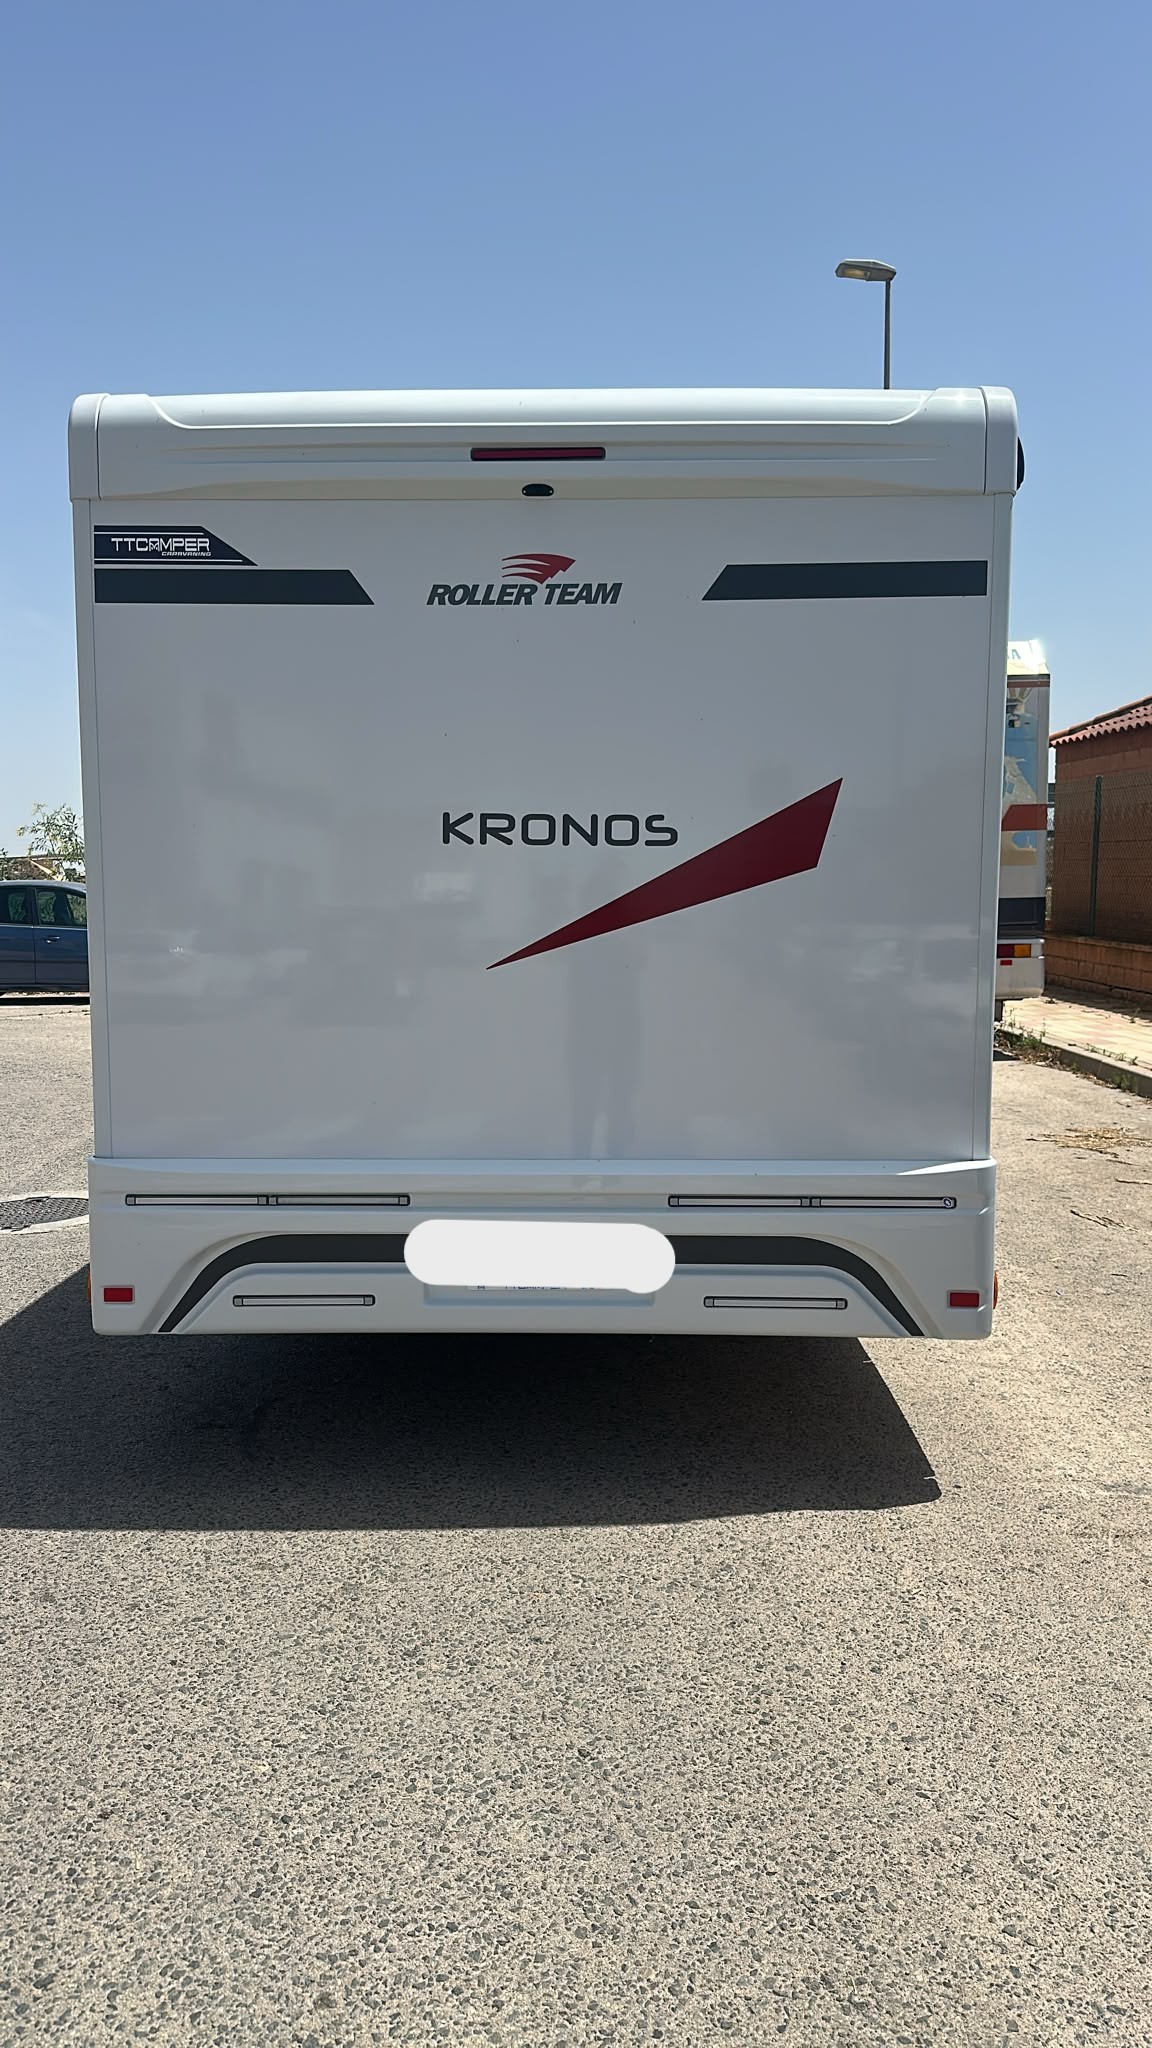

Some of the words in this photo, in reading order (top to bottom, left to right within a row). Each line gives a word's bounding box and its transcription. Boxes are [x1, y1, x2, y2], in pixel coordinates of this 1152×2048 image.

[111, 537, 210, 552] TTCAMPER
[426, 583, 539, 606] ROLLER
[544, 582, 623, 605] TEAM
[442, 811, 679, 847] KRONOS
